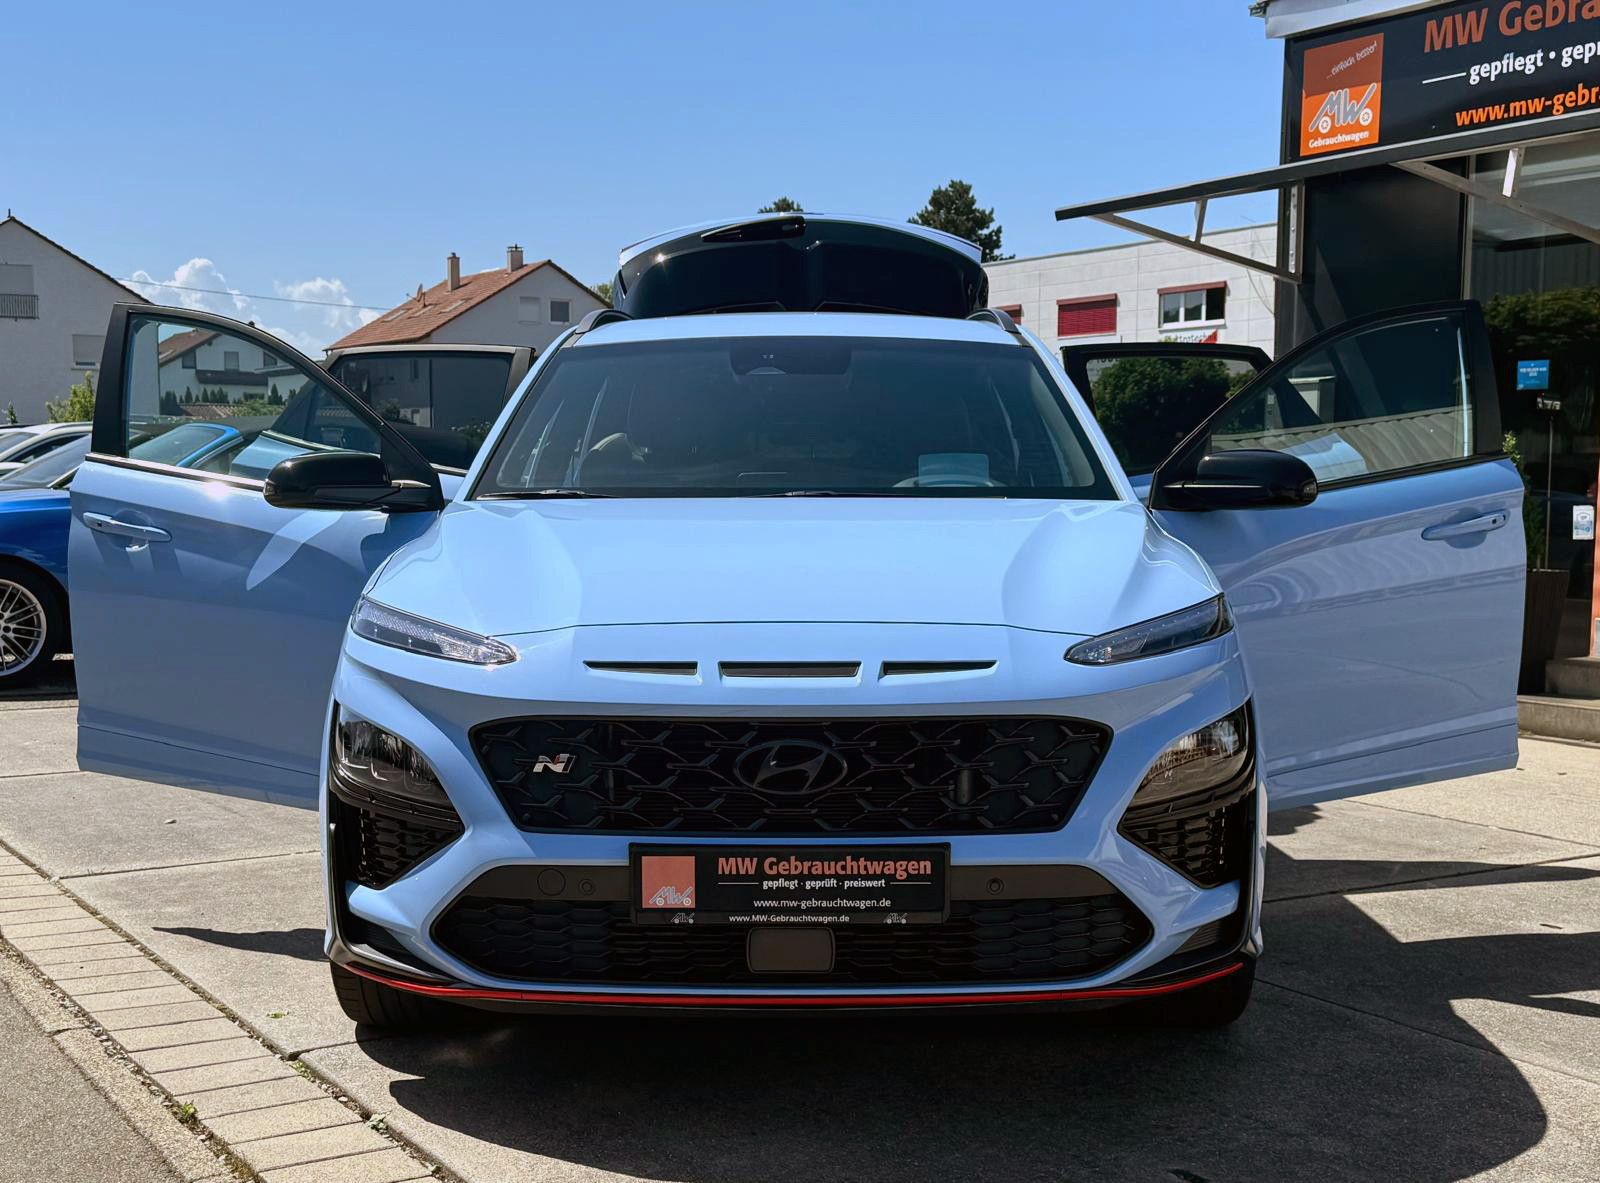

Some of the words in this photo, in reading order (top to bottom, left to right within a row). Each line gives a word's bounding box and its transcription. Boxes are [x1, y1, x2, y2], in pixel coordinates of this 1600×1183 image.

[1424, 8, 1488, 52] MW
[1469, 50, 1543, 84] gepflegt
[1455, 82, 1600, 127] www.mw-gebr
[1308, 132, 1370, 148] Gebrauchtwagen
[718, 857, 758, 875] MW
[763, 855, 932, 880] Gebrauchtwagen
[762, 878, 798, 889] gepflegt
[805, 878, 837, 889] geprüft
[844, 878, 886, 889] preiswert
[753, 897, 892, 910] www.mw-gebrauchtwagen.de
[729, 914, 850, 924] www.MW-Gebrauchtwagen.de
